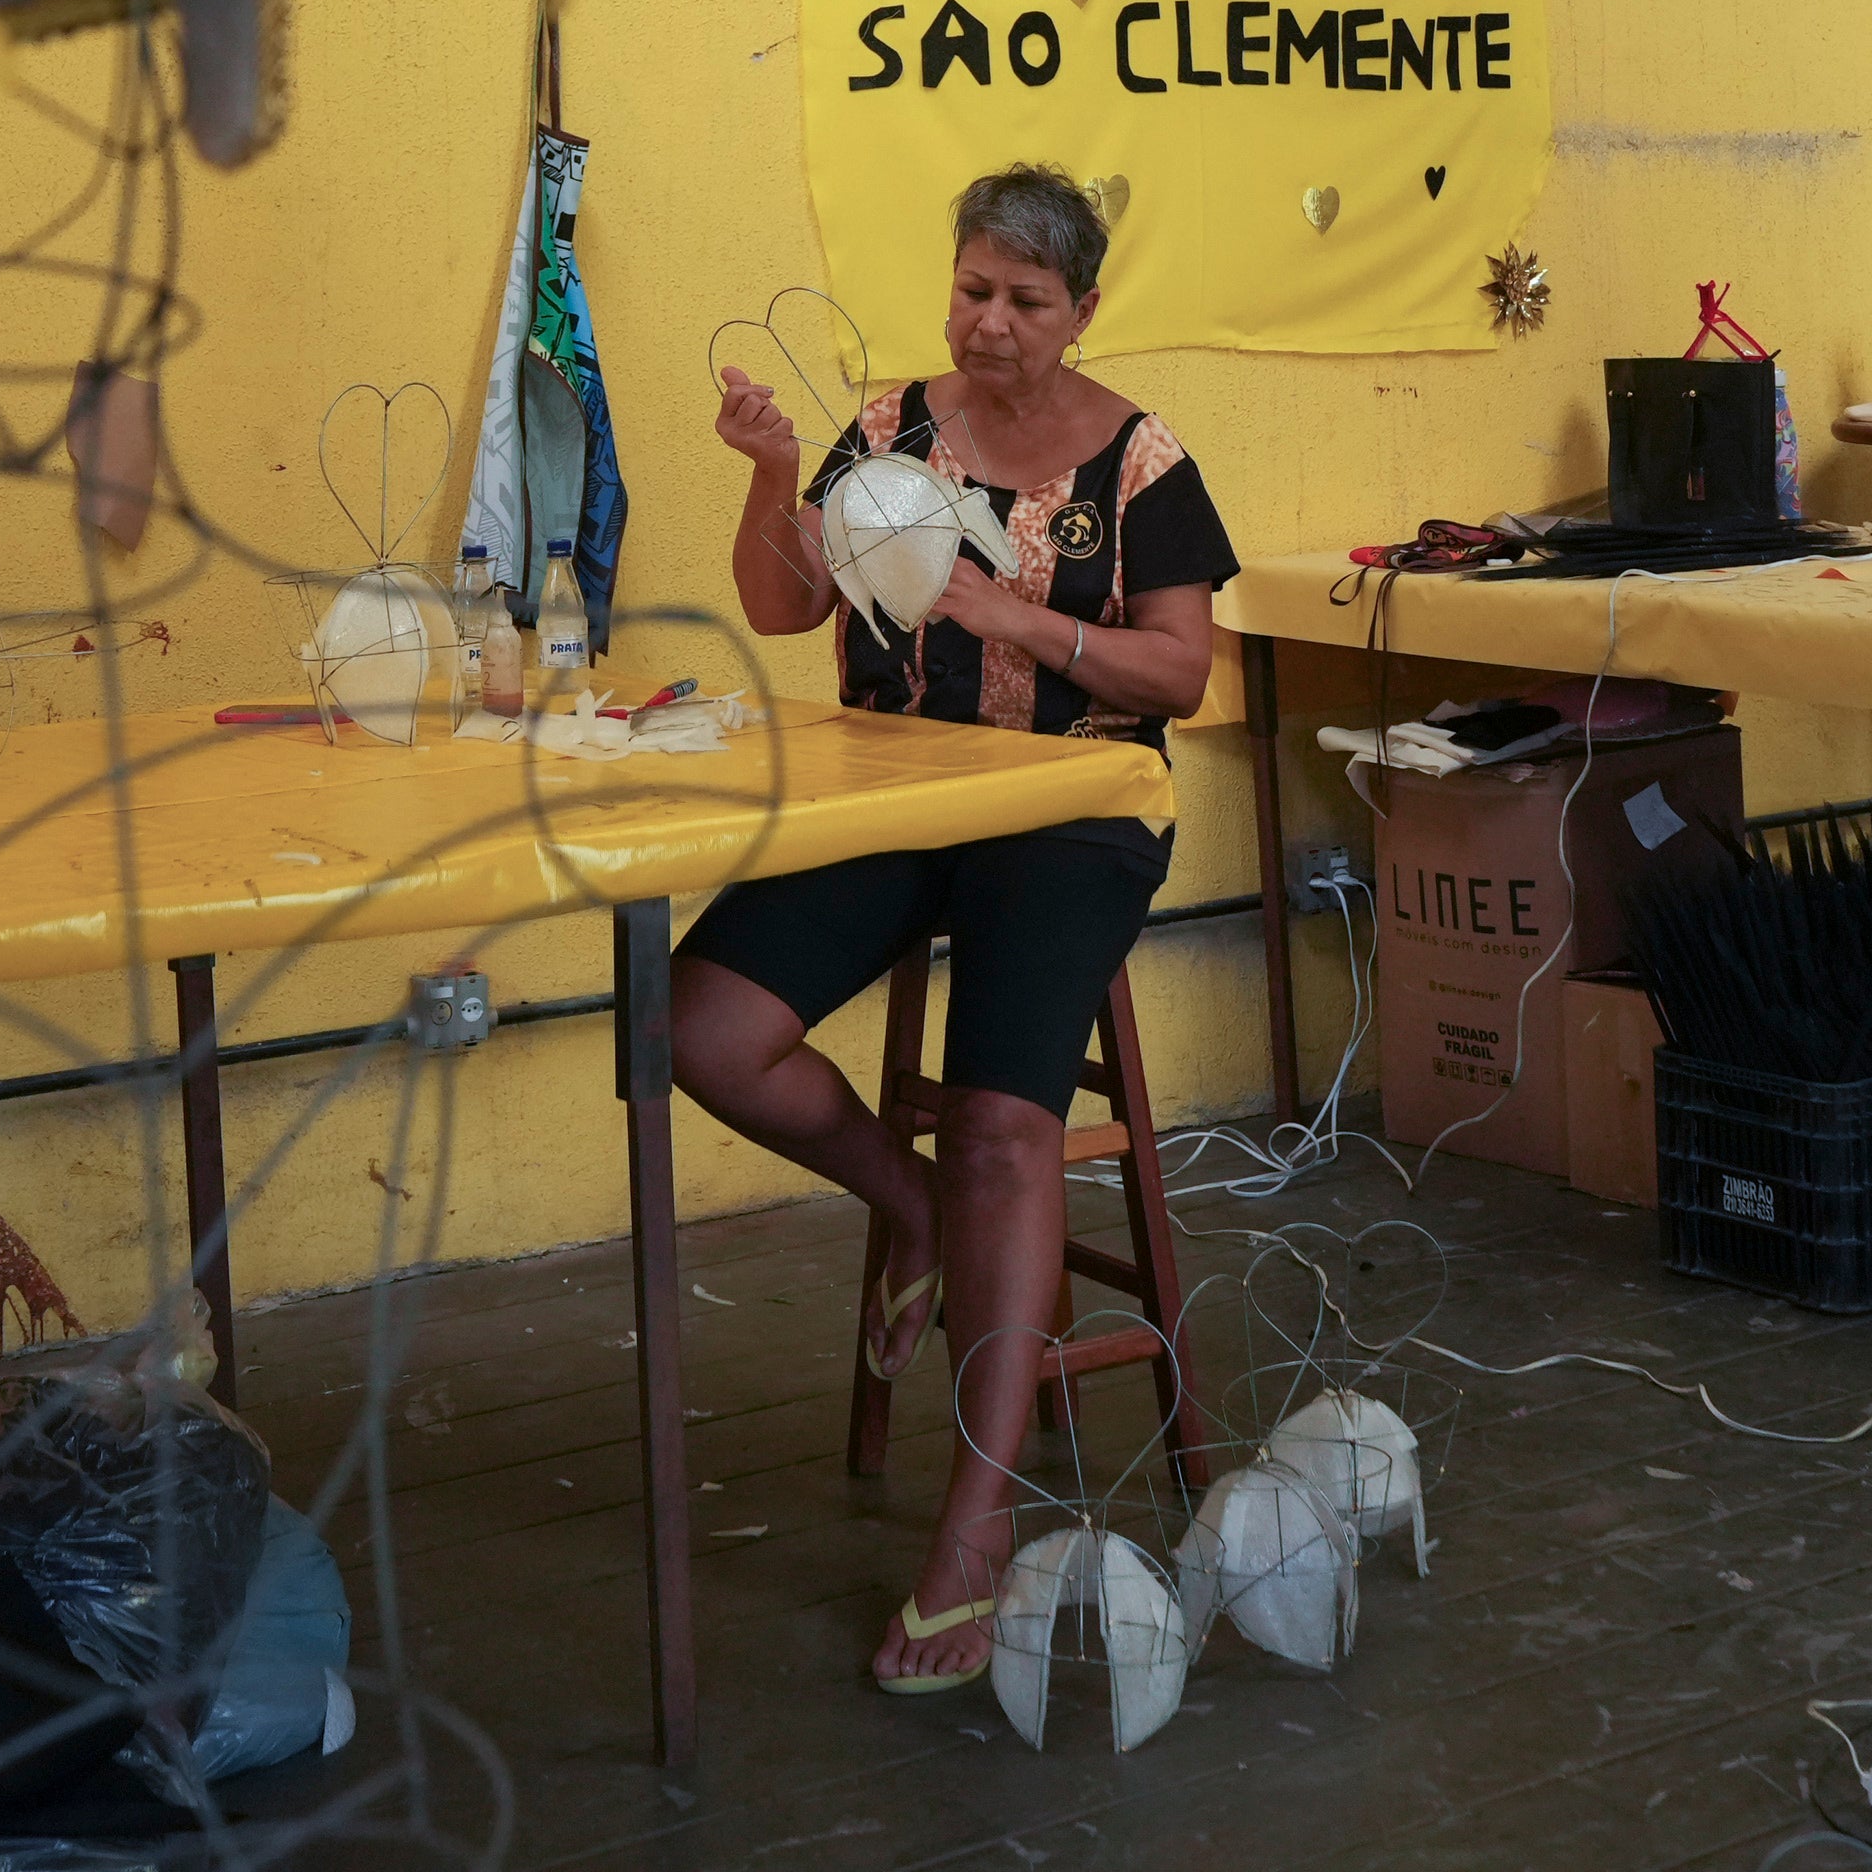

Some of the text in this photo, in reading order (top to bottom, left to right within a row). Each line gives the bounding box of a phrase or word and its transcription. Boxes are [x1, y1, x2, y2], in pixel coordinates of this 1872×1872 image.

[1115, 0, 1512, 93] CLEMENTE
[550, 642, 583, 655] PRATA
[1392, 863, 1540, 937] LINEE
[1394, 926, 1543, 960] móveis com design
[1437, 1021, 1500, 1044] CUIDADO
[1444, 1038, 1496, 1061] FRÁGIL
[1721, 1173, 1775, 1206] ZIMBRÃO
